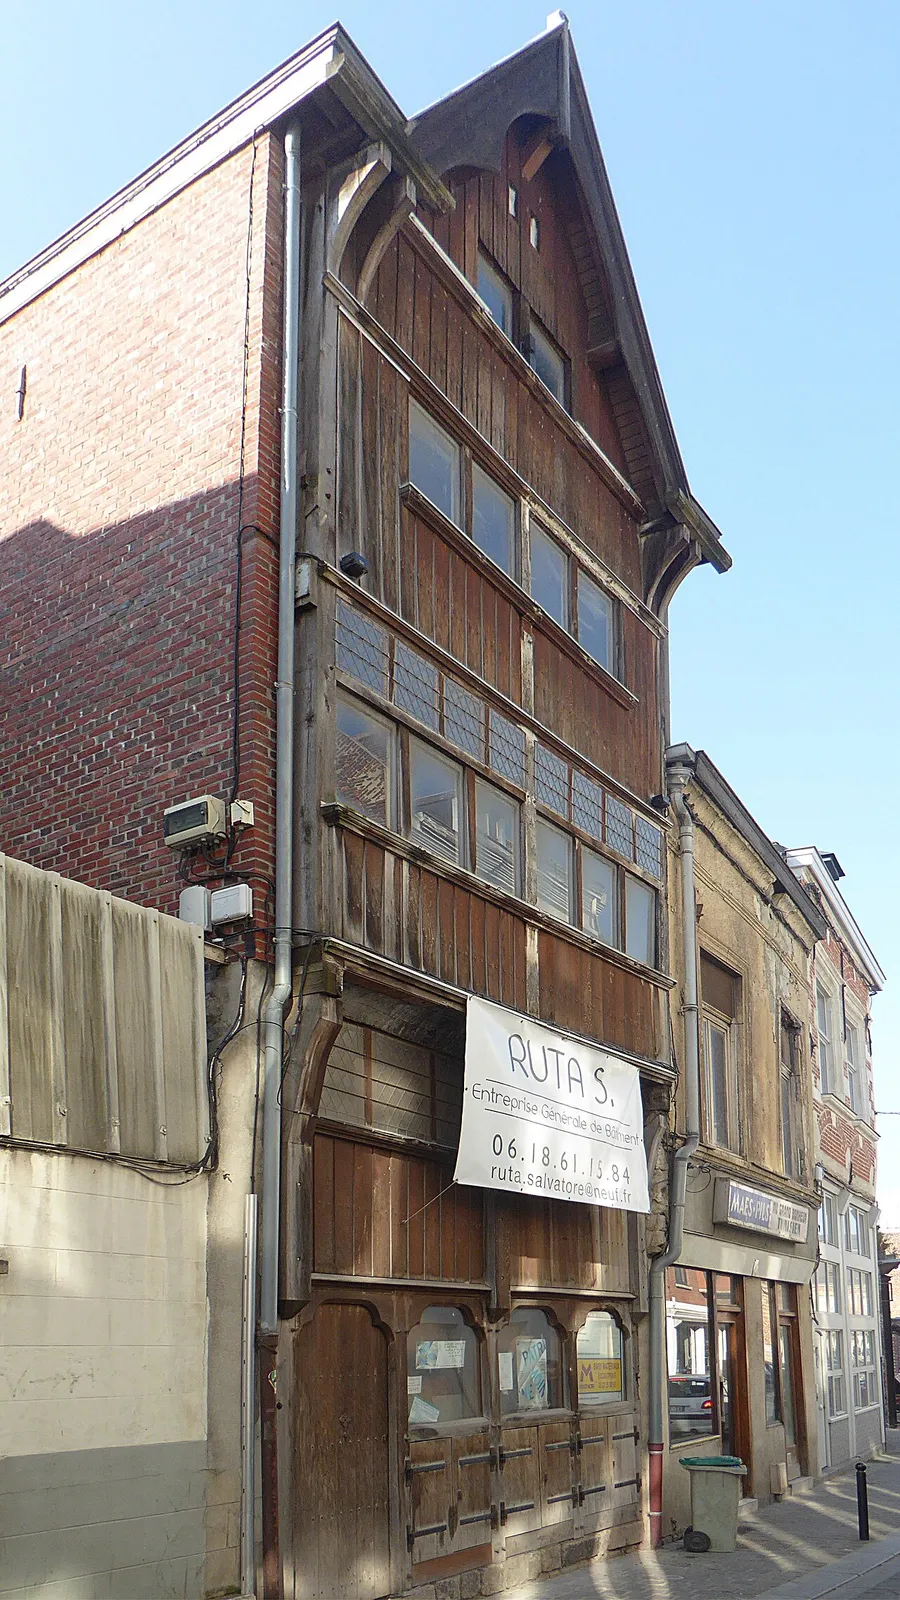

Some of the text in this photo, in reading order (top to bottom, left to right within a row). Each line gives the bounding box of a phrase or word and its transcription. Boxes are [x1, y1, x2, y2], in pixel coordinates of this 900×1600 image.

[508, 1033, 615, 1108] RUTA S.
[472, 1082, 538, 1115] Entreprise
[541, 1103, 587, 1130] Générale
[590, 1120, 602, 1134] de
[491, 1164, 632, 1204] ruta.salvatore@neuf.fr
[492, 1133, 631, 1185] 06.18.61.15.84
